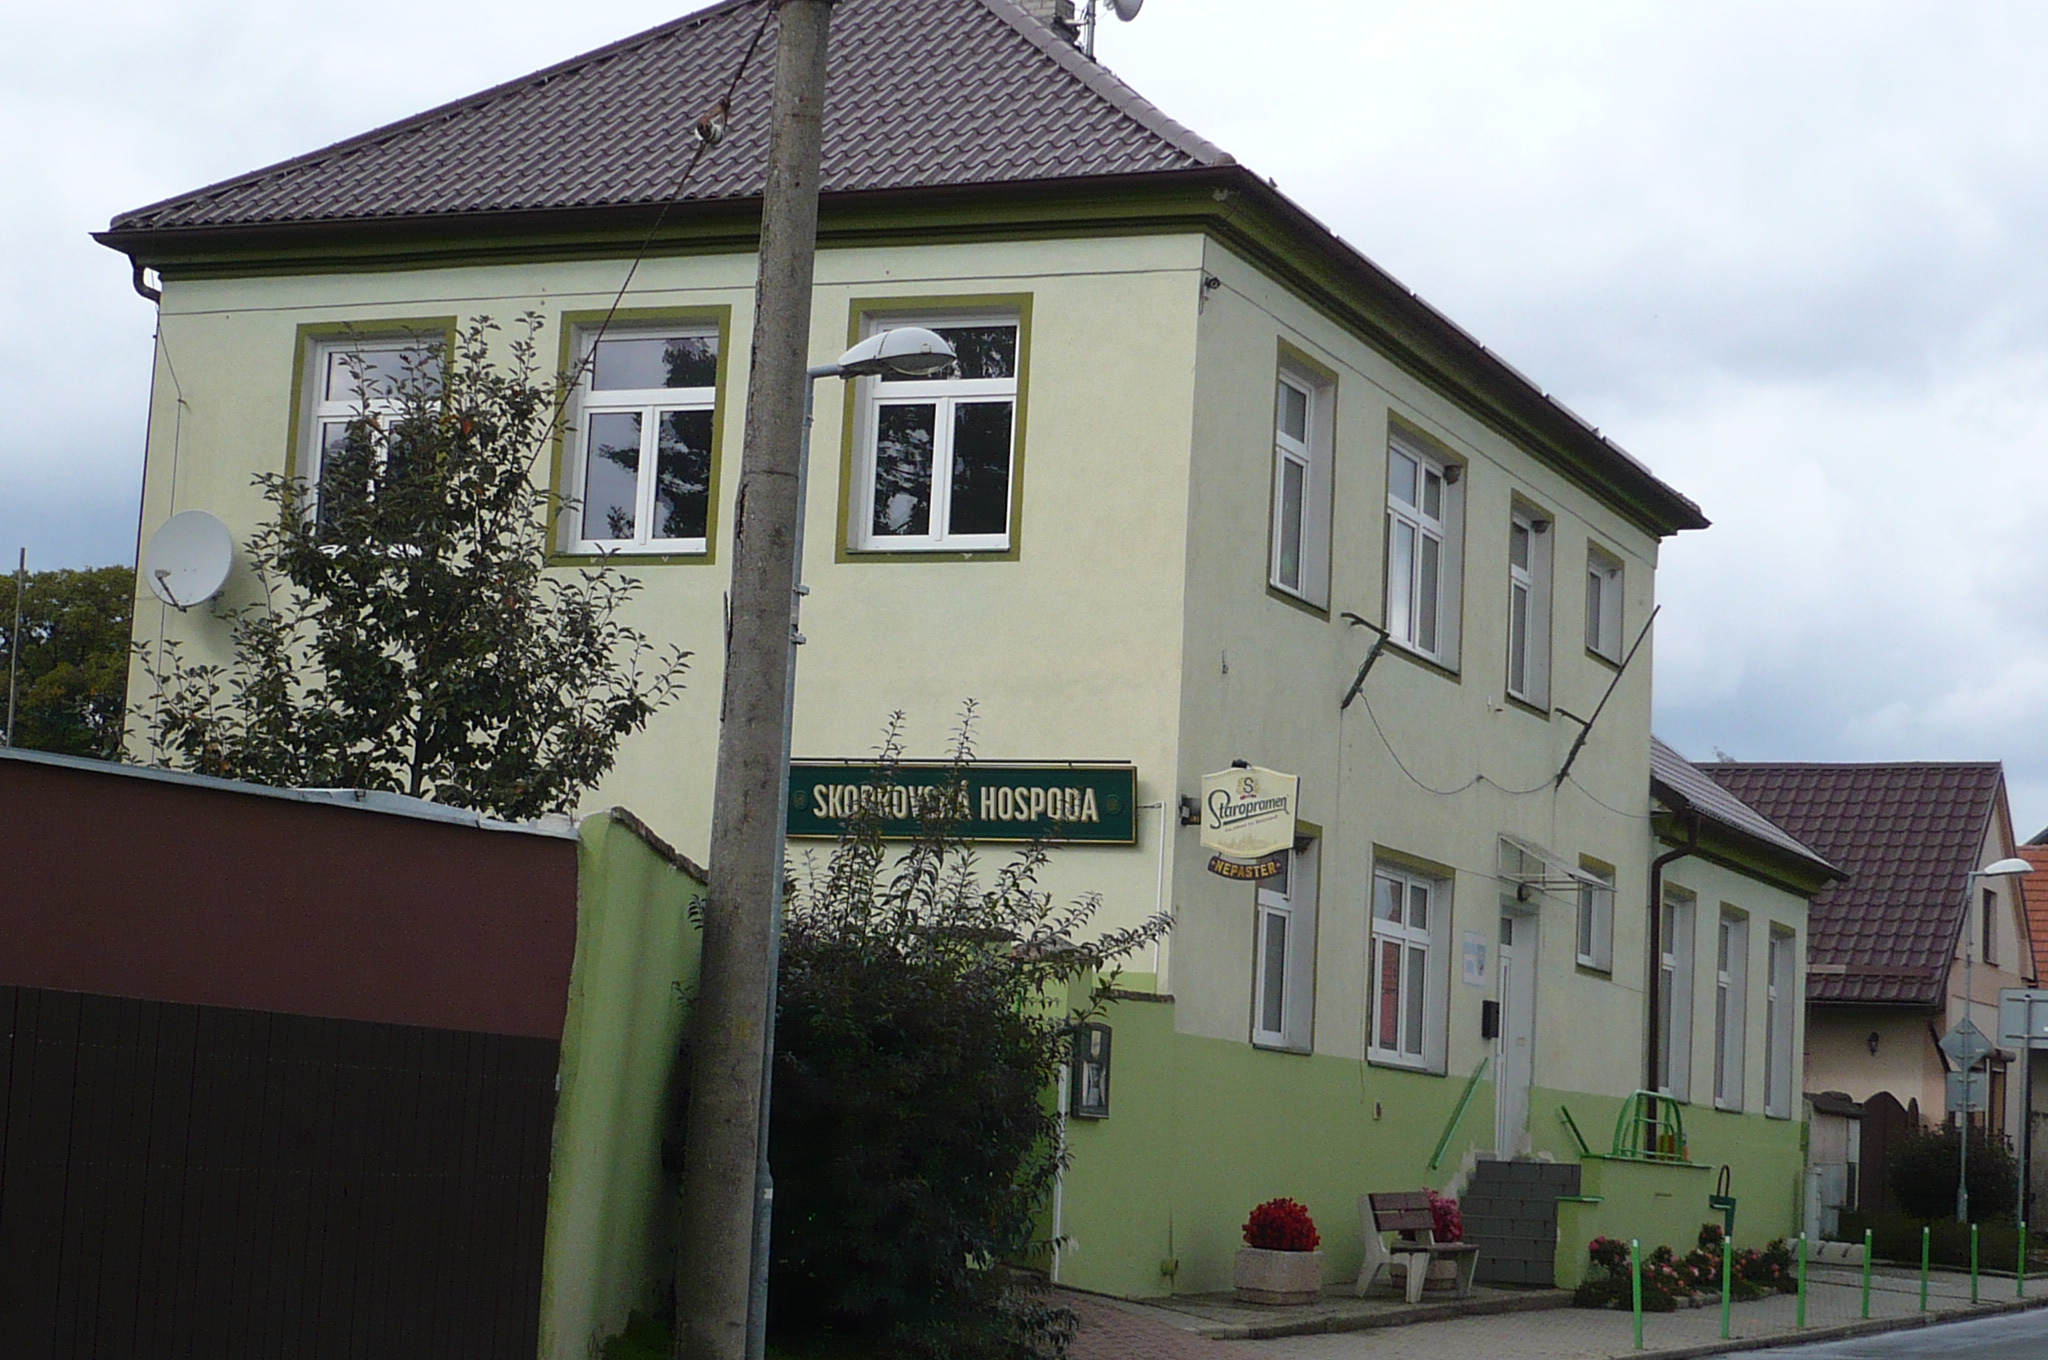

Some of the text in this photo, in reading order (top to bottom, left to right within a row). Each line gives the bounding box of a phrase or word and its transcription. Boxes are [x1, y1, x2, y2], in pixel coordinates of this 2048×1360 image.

[813, 780, 1100, 823] SKORKOVSÁ HOSPODA
[1208, 789, 1290, 829] Staropramen
[1214, 859, 1277, 878] NEPASTER
